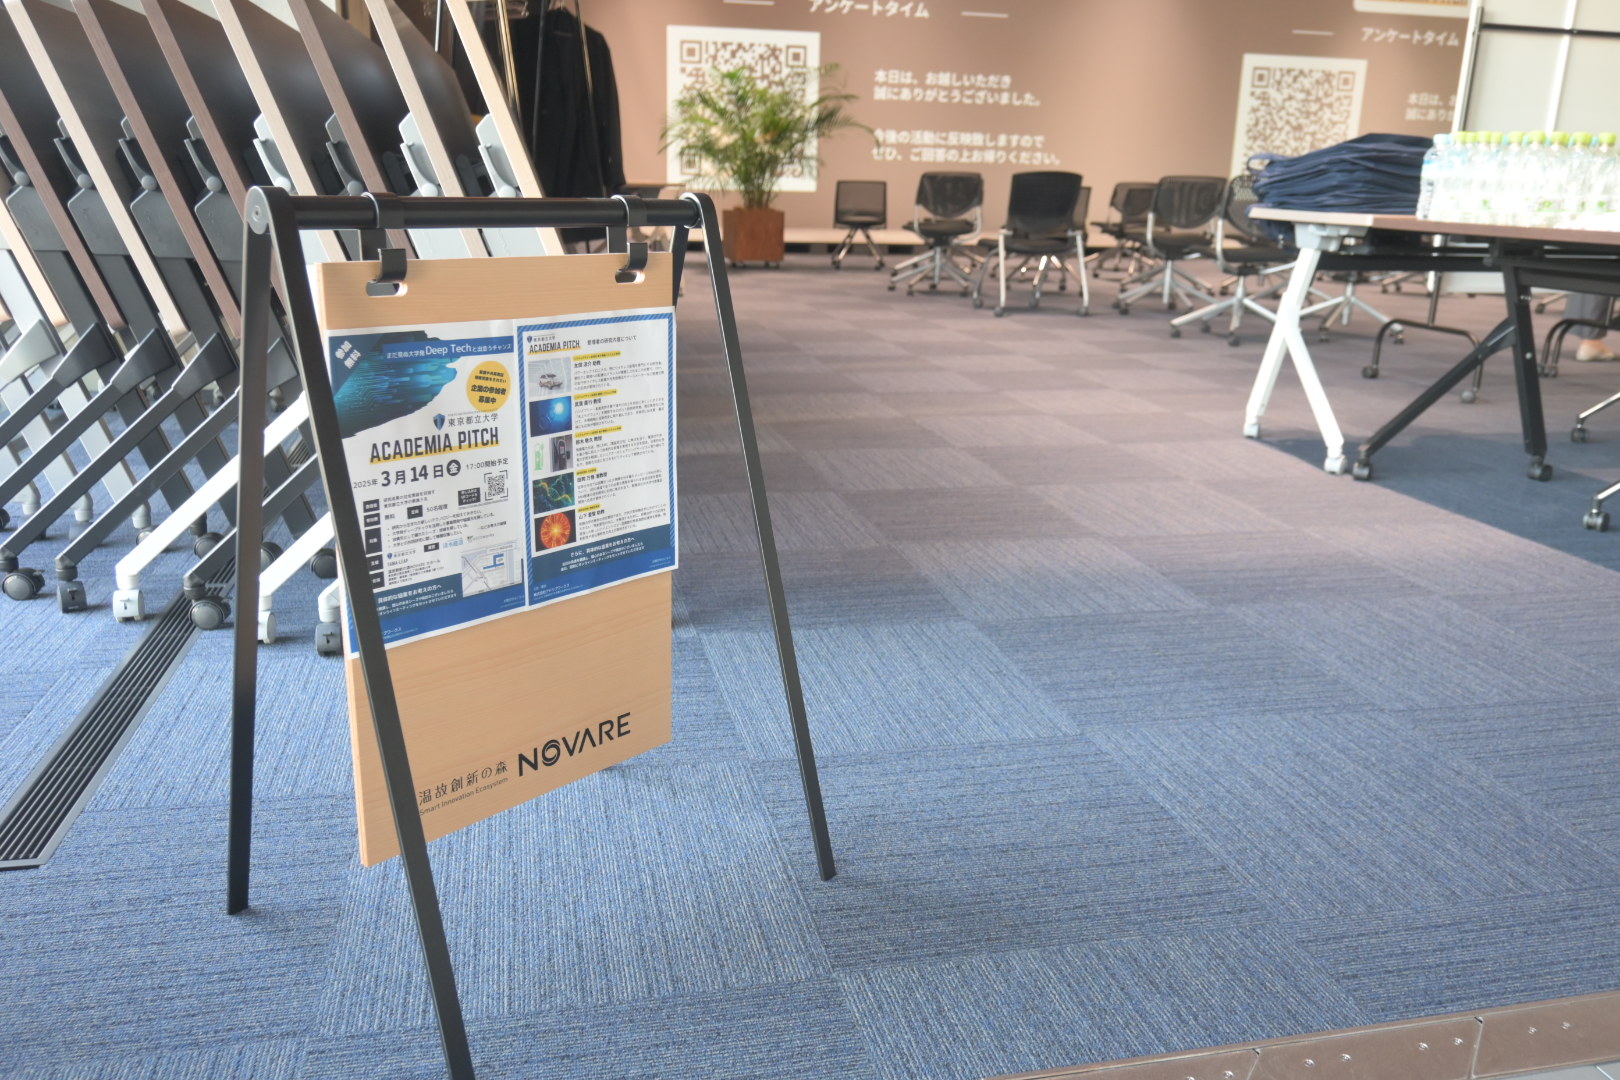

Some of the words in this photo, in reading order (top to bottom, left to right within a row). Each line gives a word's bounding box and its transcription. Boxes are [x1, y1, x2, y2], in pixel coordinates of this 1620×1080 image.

[808, 0, 930, 18] アンケートタイム
[1361, 27, 1459, 47] アンケートタイム
[874, 70, 1012, 89] 本日は、お越しいただき
[873, 86, 1041, 107] 誠にありがとうございました。
[529, 342, 561, 354] ACADEMIA
[562, 339, 580, 350] PITCH
[448, 412, 499, 428] 東京都立大学
[370, 433, 452, 463] ACADEMIA
[458, 426, 499, 449] PITCH
[353, 479, 378, 489] 2025年
[419, 760, 508, 806] 温故創新の森
[518, 712, 631, 777] NOVARE
[441, 790, 475, 807] Innovation
[475, 776, 508, 797] Ecosystem
